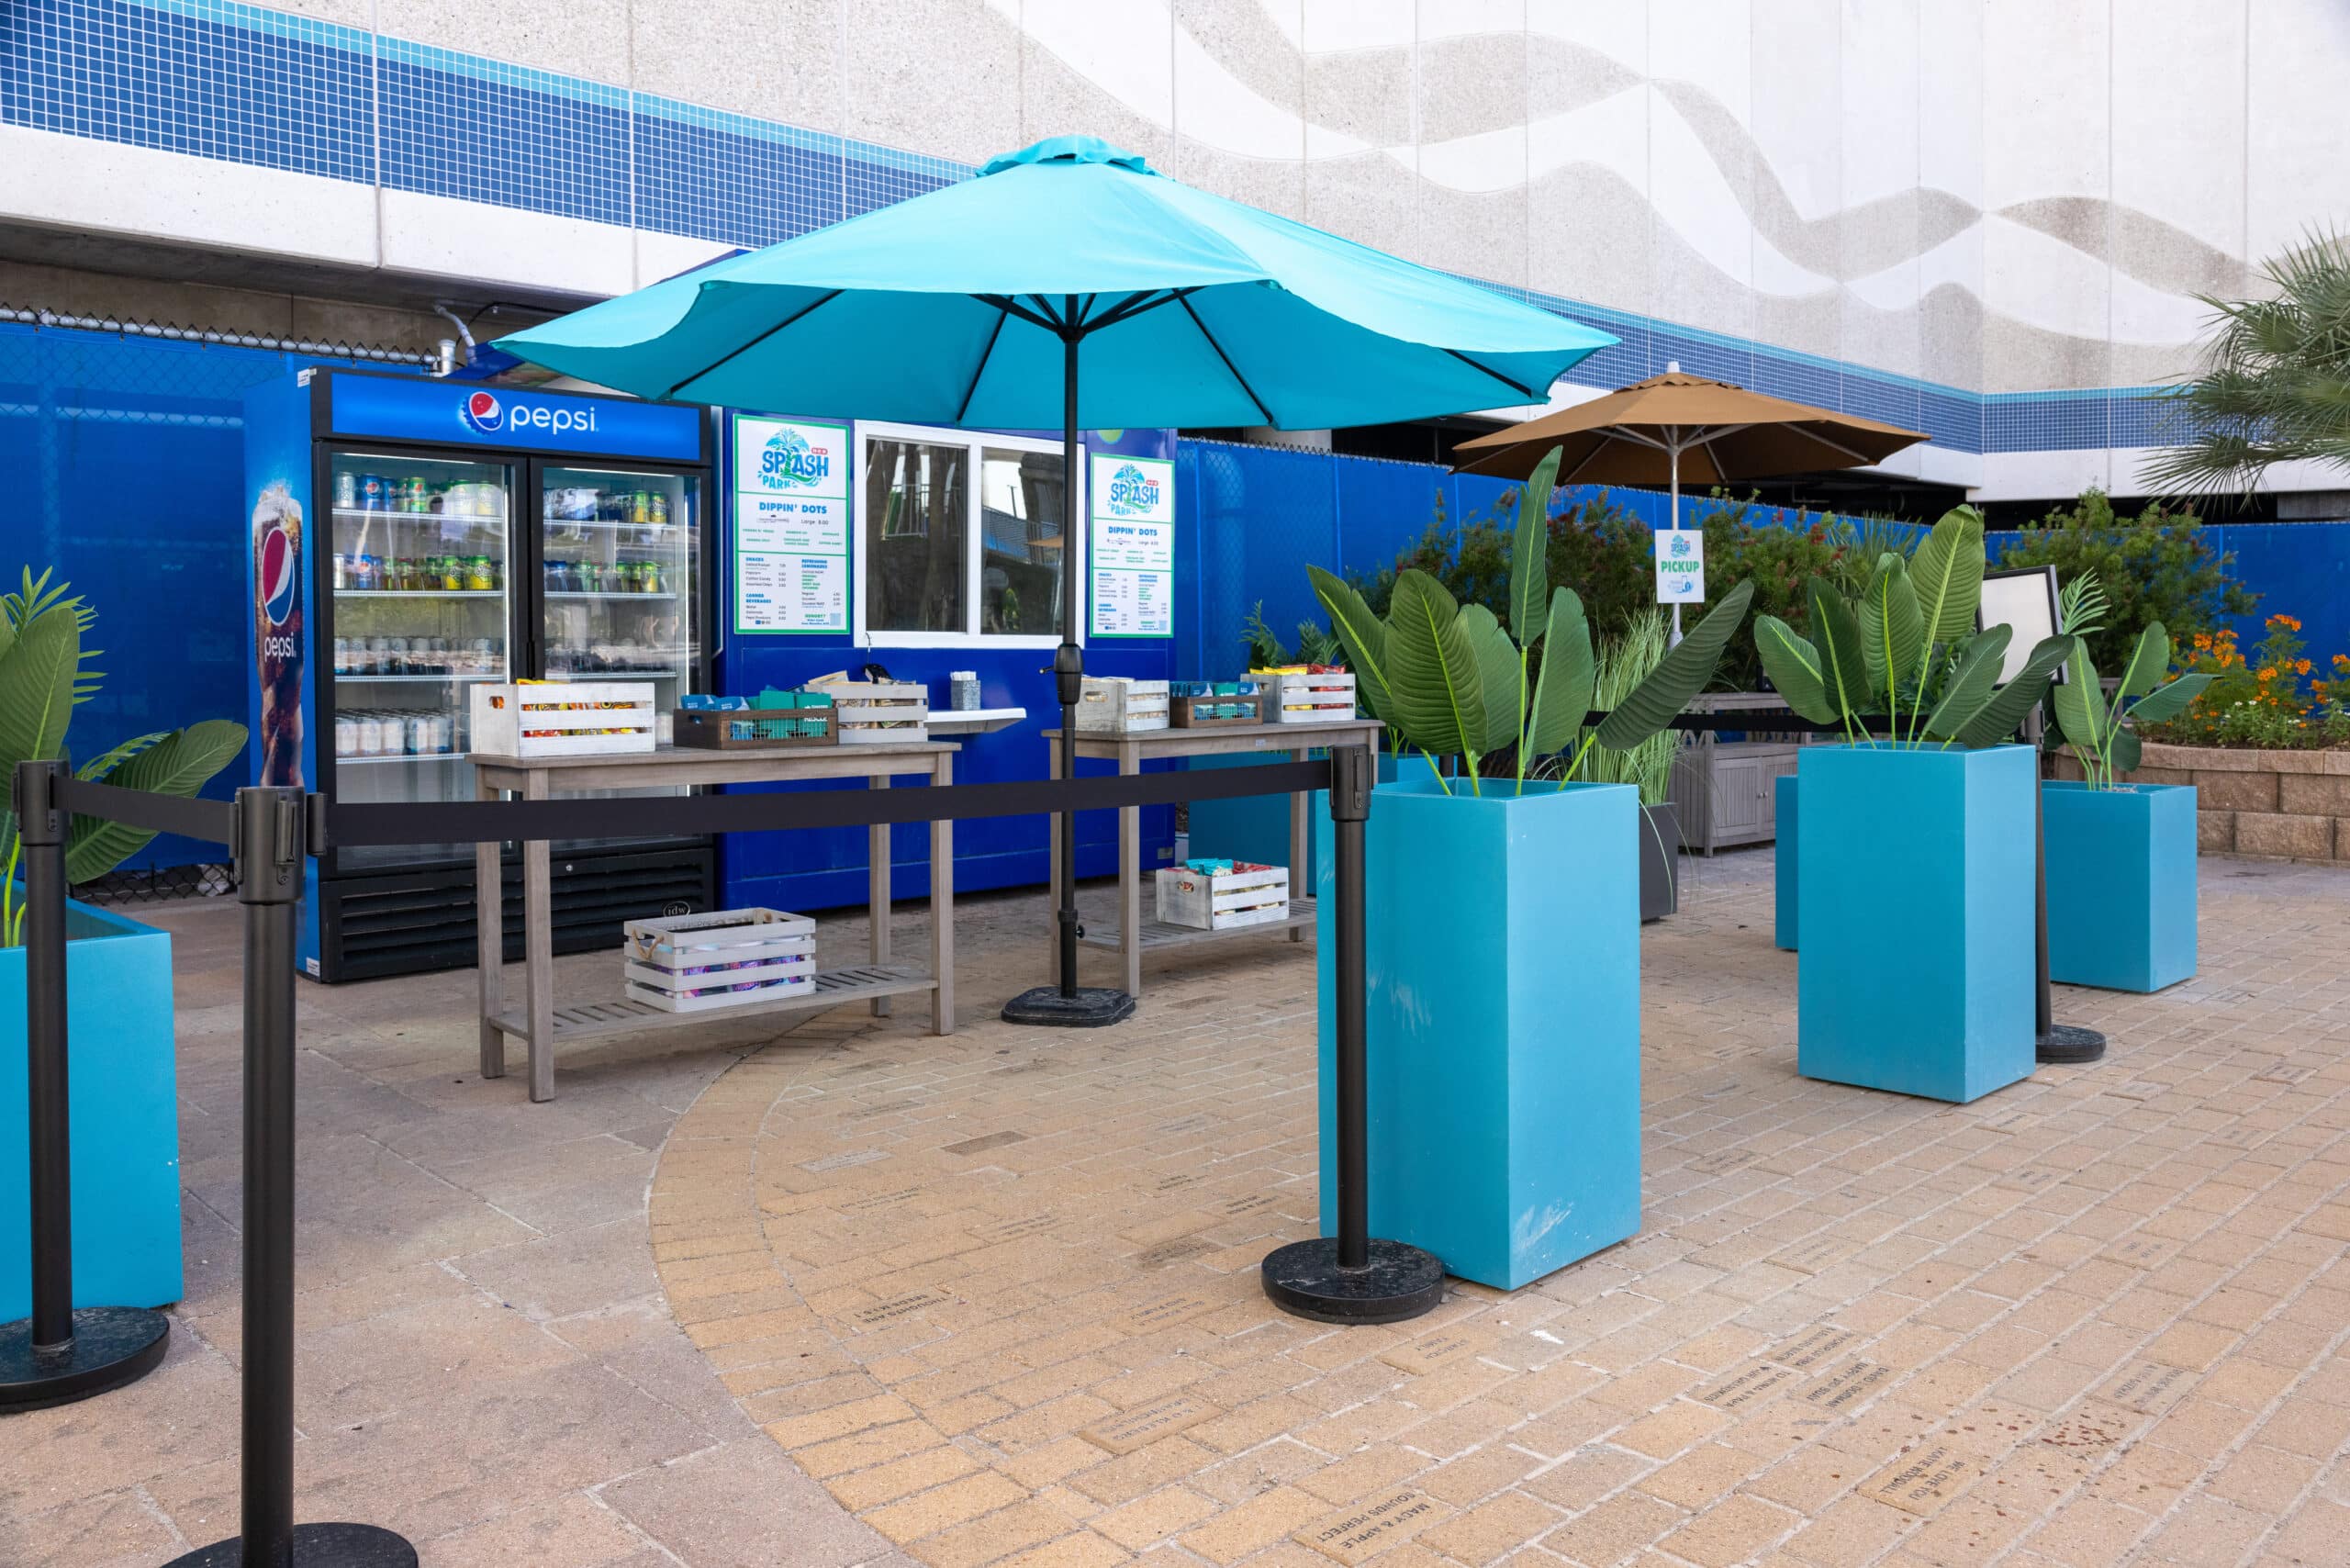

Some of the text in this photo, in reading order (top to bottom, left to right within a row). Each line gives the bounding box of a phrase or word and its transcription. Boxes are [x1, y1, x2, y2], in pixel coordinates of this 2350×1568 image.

[509, 405, 596, 435] pepsi
[762, 449, 829, 478] SPLASH
[763, 476, 790, 489] PARK
[1111, 483, 1159, 505] SPLASH
[759, 502, 828, 514] DIPPIN' DOTS
[1139, 528, 1158, 536] DOTS
[1661, 560, 1700, 573] PICKUP
[264, 632, 295, 663] pepsi
[887, 1297, 948, 1316] THOUGHTS
[1316, 1492, 1416, 1542] SOUNDS PERFECT
[1339, 1526, 1382, 1549] APPLE
